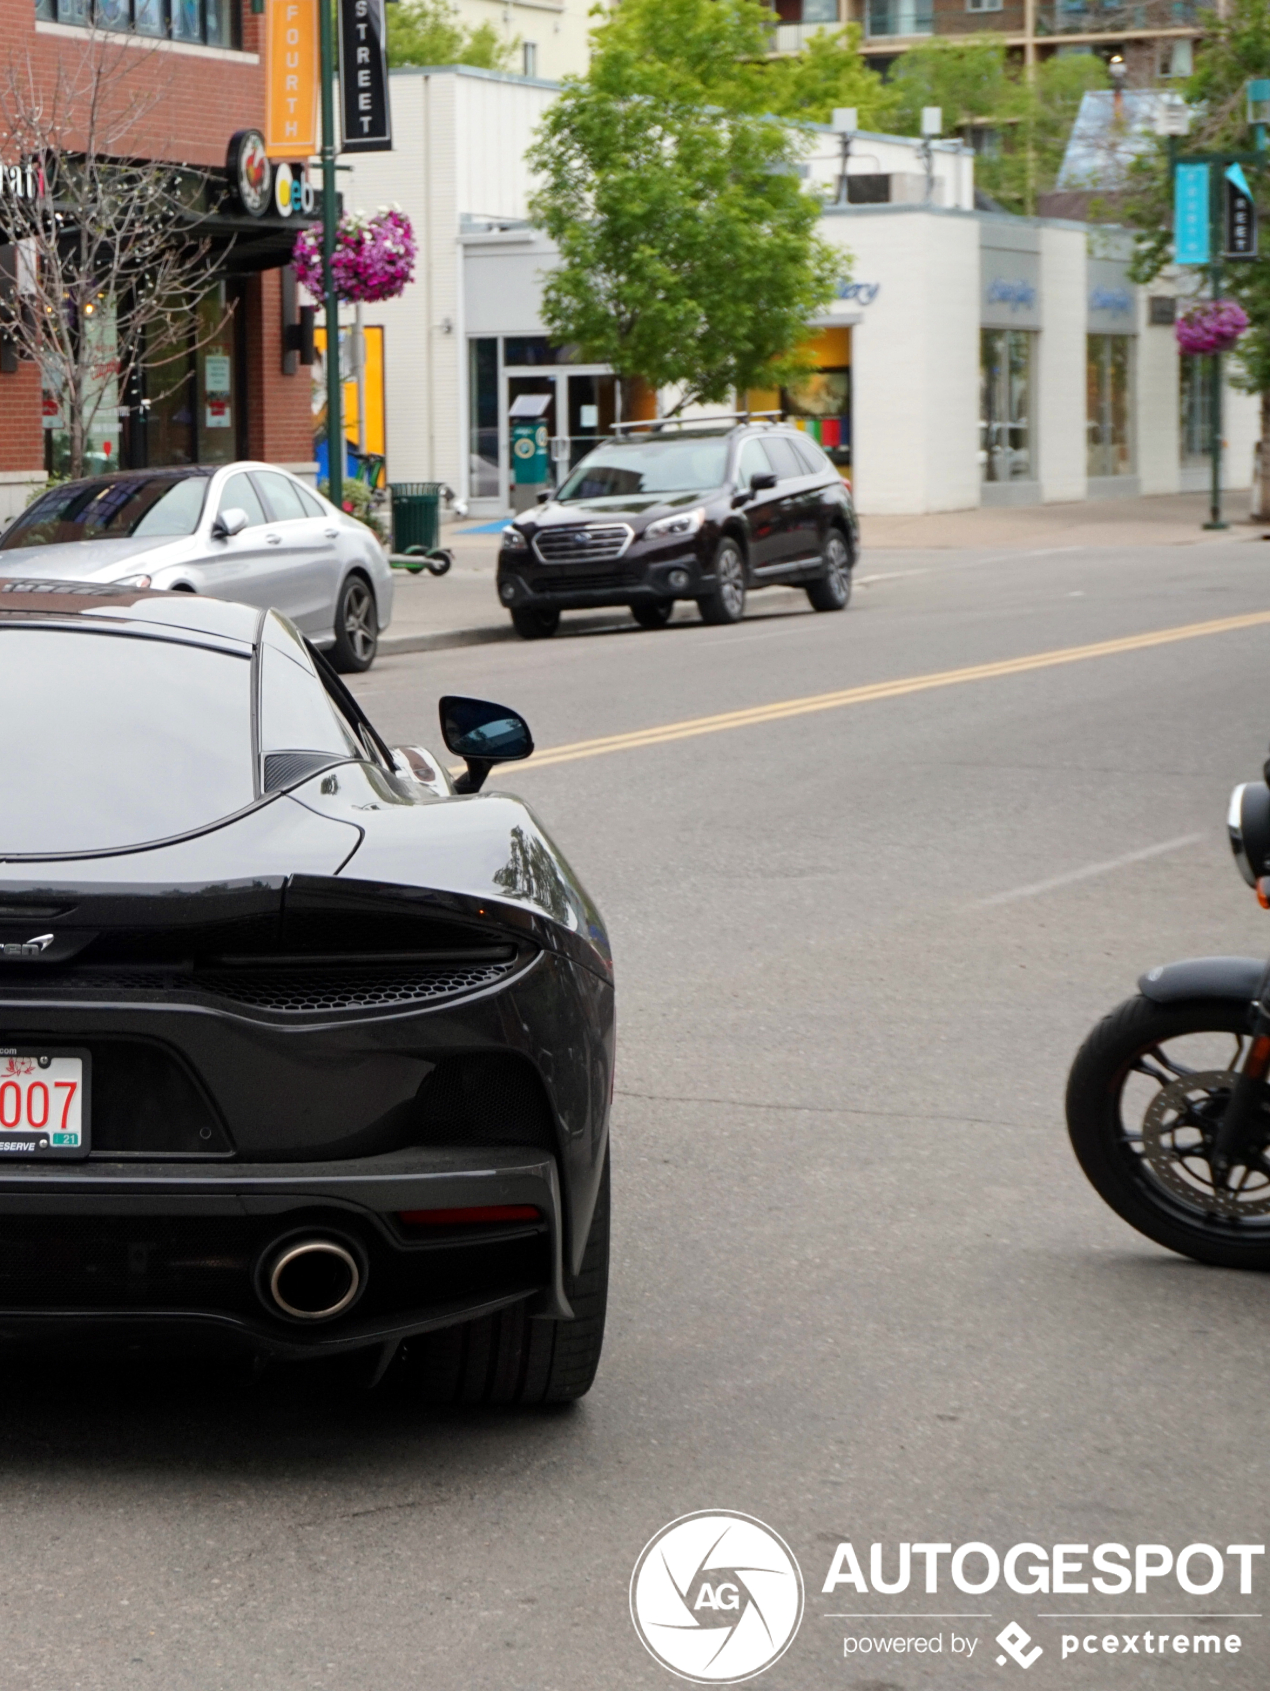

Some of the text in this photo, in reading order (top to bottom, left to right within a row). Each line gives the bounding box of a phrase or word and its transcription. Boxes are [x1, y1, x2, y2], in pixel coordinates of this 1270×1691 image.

[285, 5, 299, 137] FOURTH
[355, 1, 373, 134] STREET
[63, 1134, 76, 1144] 21
